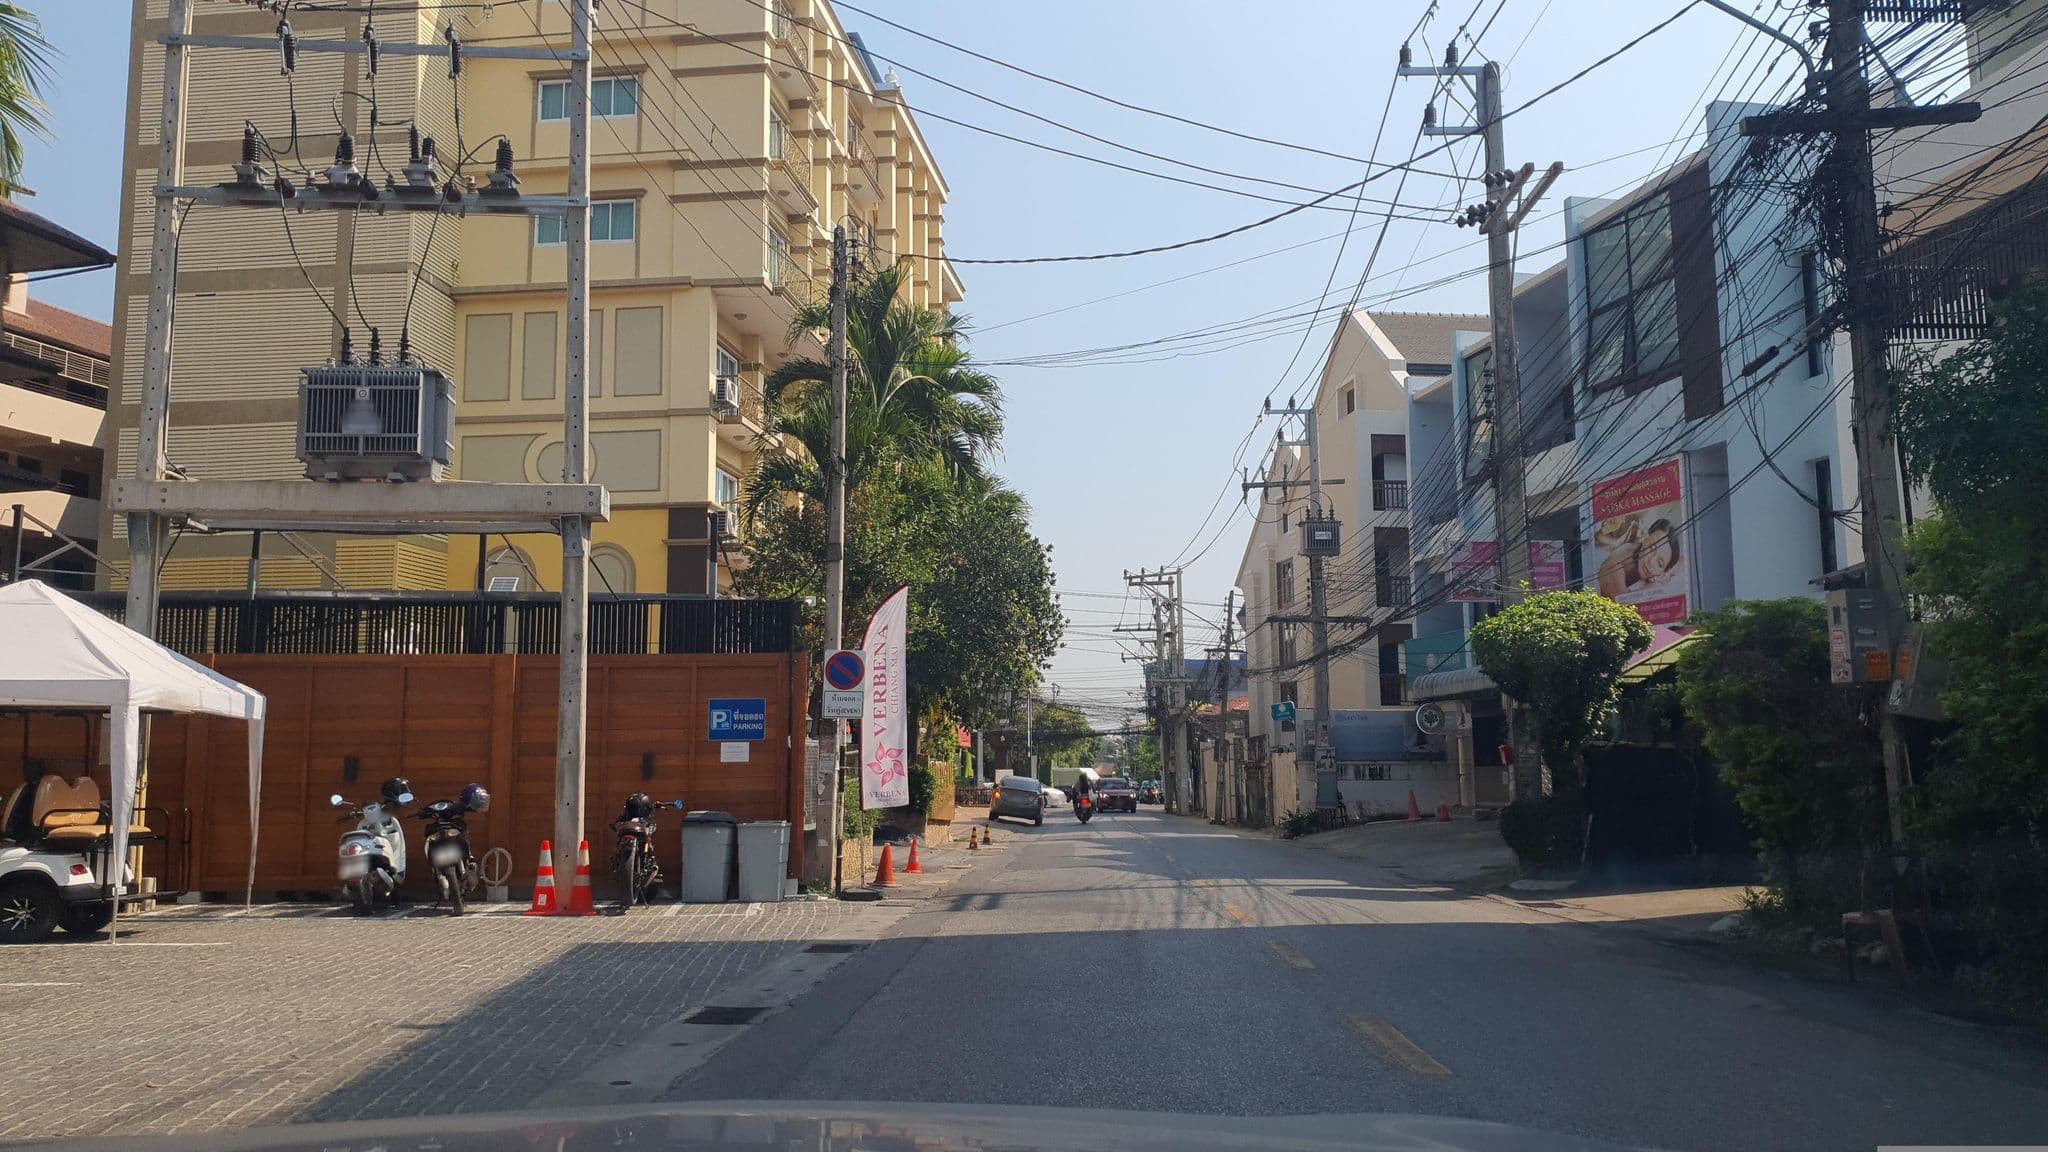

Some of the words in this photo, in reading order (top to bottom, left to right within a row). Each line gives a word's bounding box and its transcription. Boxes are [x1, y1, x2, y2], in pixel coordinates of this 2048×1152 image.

[890, 646, 899, 667] MAI
[873, 624, 889, 737] VERBENA
[890, 670, 899, 714] CHIANG
[712, 711, 727, 729] P
[733, 709, 764, 721] ที่จอดรถ
